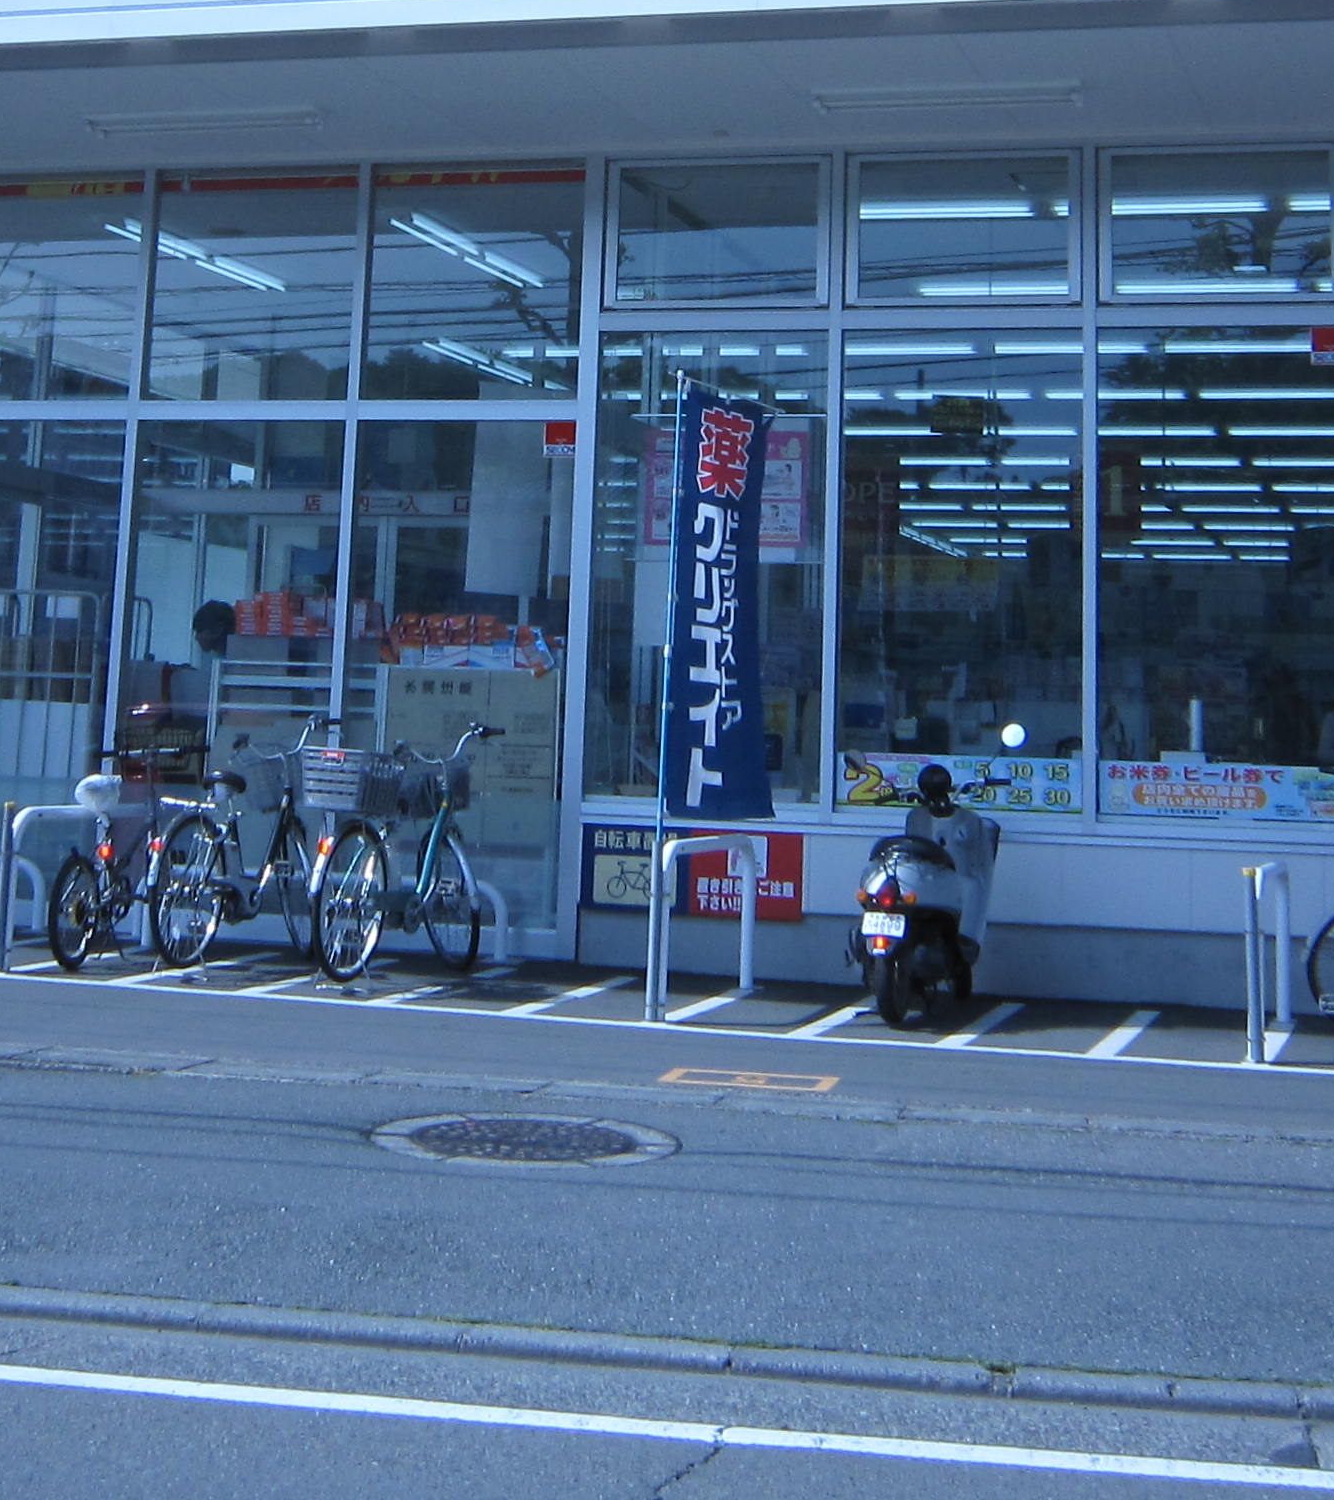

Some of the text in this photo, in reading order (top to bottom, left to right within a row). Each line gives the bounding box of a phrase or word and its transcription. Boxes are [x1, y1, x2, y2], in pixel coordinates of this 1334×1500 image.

[695, 406, 755, 501] 薬
[1100, 464, 1128, 517] 1
[685, 501, 726, 808] クリエイト
[1007, 762, 1033, 779] 10
[1044, 763, 1070, 781] 15
[1007, 787, 1033, 805] 25
[1044, 788, 1071, 806] 30
[696, 876, 795, 899] 置き引きご注意
